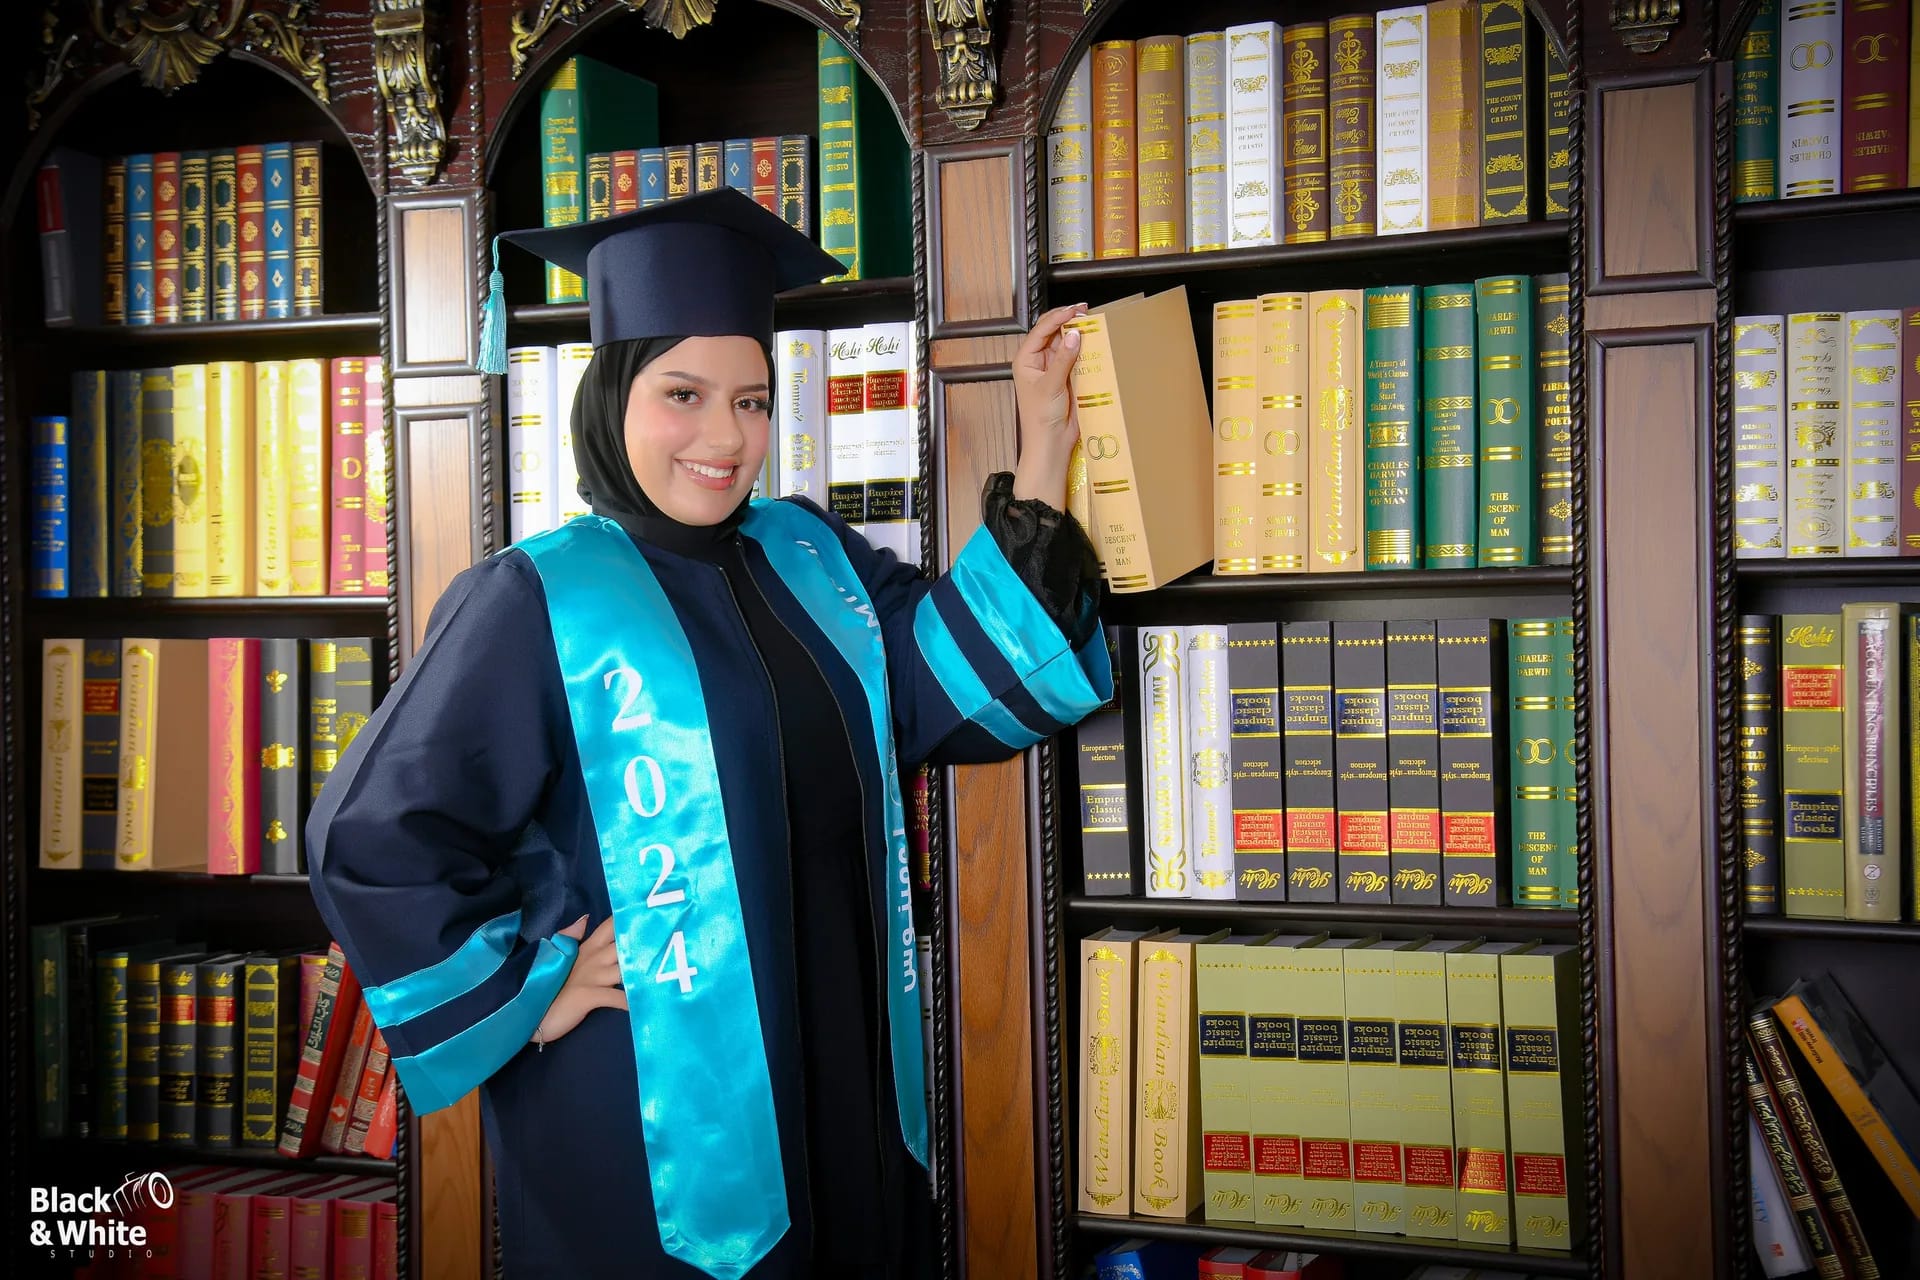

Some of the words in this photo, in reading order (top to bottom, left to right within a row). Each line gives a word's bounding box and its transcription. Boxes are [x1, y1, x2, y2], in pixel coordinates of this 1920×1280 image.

[1491, 114, 1518, 123] CRISTO
[1791, 135, 1830, 148] DARWIN
[1789, 151, 1832, 164] CHARLES
[1542, 382, 1569, 392] LIBRA
[1555, 394, 1568, 402] OF
[1368, 462, 1409, 470] CHARLES
[1369, 471, 1407, 479] DARWIN
[869, 488, 904, 498] Empire
[1368, 488, 1409, 496] DESCENT
[1371, 497, 1382, 505] OF
[1383, 497, 1406, 505] MAN
[1490, 493, 1509, 501] THE
[871, 500, 900, 508] classic
[872, 508, 901, 516] books
[1487, 504, 1520, 514] ESCENT
[1493, 516, 1506, 525] OF
[1109, 524, 1124, 532] THE
[1490, 528, 1510, 537] MAN
[1105, 534, 1137, 545] DESCENT
[1116, 546, 1126, 555] OF
[1116, 556, 1131, 566] MAN
[1236, 697, 1271, 705] books
[1290, 695, 1324, 703] books
[1344, 698, 1378, 706] books
[1394, 693, 1429, 702] books
[1446, 696, 1482, 705] books
[1237, 707, 1271, 715] classic
[1395, 704, 1429, 712] classic
[1446, 707, 1483, 715] classic
[1234, 717, 1275, 726] Empire
[1287, 715, 1328, 724] Empire
[1342, 718, 1383, 727] Empire
[1391, 714, 1432, 723] Empire
[1443, 717, 1486, 726] Empire
[1081, 744, 1124, 754] European-style
[1091, 753, 1116, 762] selection
[1866, 736, 1878, 812] PRINCIPLES
[1087, 795, 1125, 806] Empire
[1090, 805, 1122, 814] classic
[1791, 802, 1838, 813] Empire
[1091, 814, 1122, 824] books
[1793, 813, 1835, 823] classic
[603, 666, 698, 994] 2024
[1795, 823, 1835, 834] books
[1528, 832, 1545, 840] THE
[1531, 856, 1543, 864] OF
[1528, 867, 1547, 875] MAN
[1096, 967, 1115, 1030] Book
[1154, 967, 1171, 1077] Wandian
[1206, 1020, 1240, 1028] books
[1256, 1022, 1290, 1030] books
[1206, 1029, 1240, 1037] classic
[1303, 1024, 1337, 1033] books
[1354, 1026, 1388, 1035] books
[1303, 1034, 1338, 1042] classic
[1405, 1029, 1440, 1038] books
[1460, 1032, 1494, 1041] books
[1354, 1036, 1389, 1044] classic
[1405, 1039, 1440, 1047] classic
[1515, 1034, 1551, 1043] books
[1203, 1040, 1244, 1049] Empire
[1254, 1042, 1295, 1051] Empire
[1460, 1042, 1495, 1051] classic
[1300, 1045, 1342, 1054] Empire
[1351, 1046, 1393, 1056] Empire
[1515, 1045, 1552, 1054] classic
[1402, 1050, 1445, 1060] Empire
[1457, 1053, 1498, 1063] Empire
[1512, 1055, 1557, 1065] Empire
[1094, 1078, 1111, 1188] Wandian
[1150, 1127, 1169, 1191] Book
